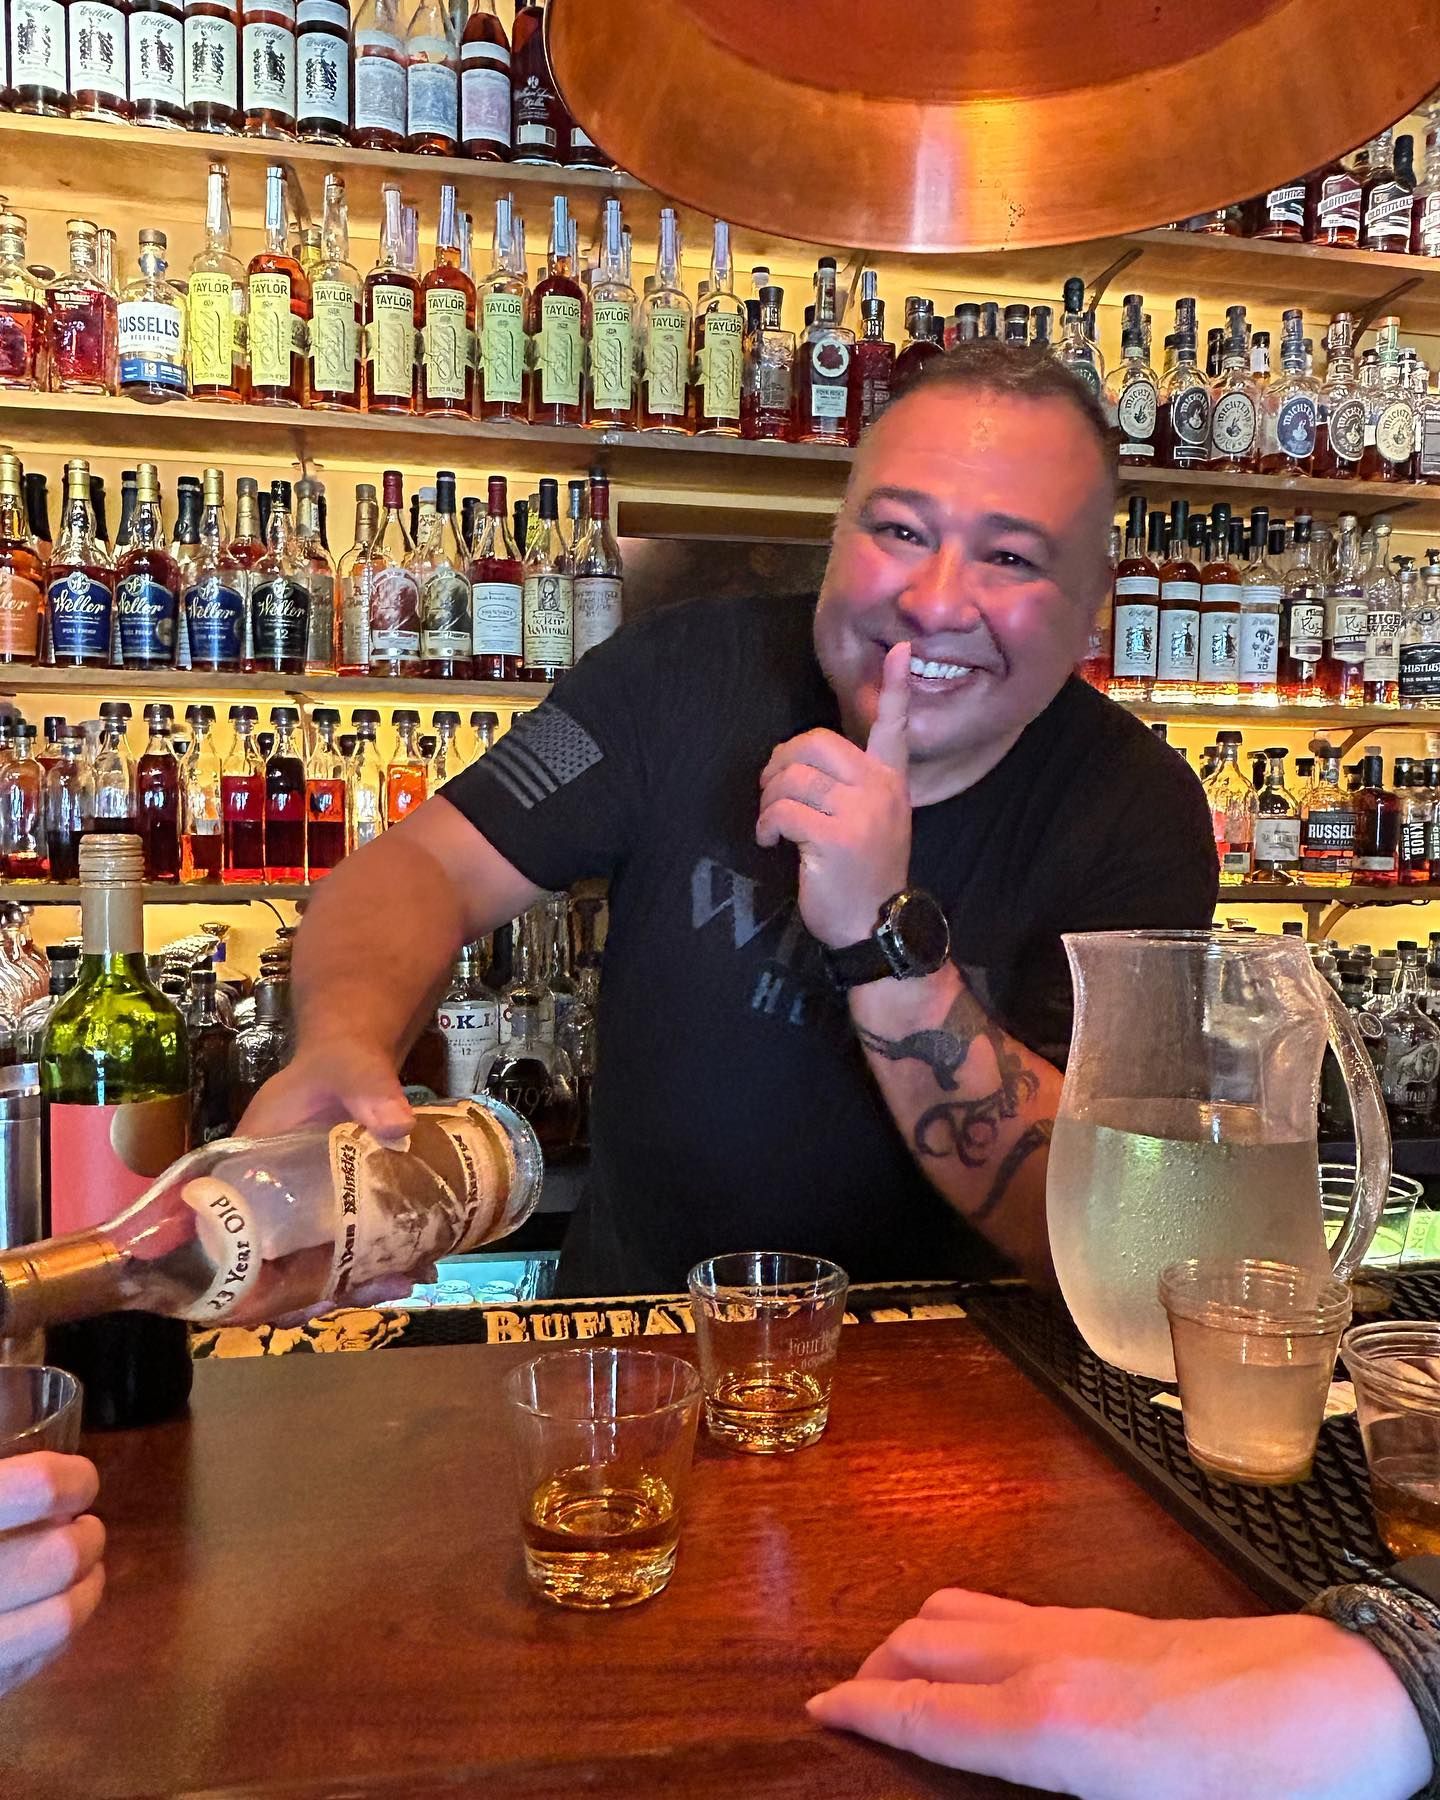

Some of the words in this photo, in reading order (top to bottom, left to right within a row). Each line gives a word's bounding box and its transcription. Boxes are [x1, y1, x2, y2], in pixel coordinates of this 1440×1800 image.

[193, 282, 229, 295] TAYLOR
[251, 283, 288, 295] TAYLOR
[315, 290, 353, 302] TAYLOR
[375, 295, 412, 310] TAYLOR
[428, 298, 464, 311] TAYLOR
[485, 302, 521, 314] TAYLOR
[594, 310, 630, 322] TAYLOR
[53, 588, 105, 614] Weller
[118, 592, 164, 615] Weller
[187, 596, 235, 619] Weller
[258, 593, 306, 618] Weller
[1403, 827, 1411, 861] CREEK
[1410, 822, 1424, 855] KNOB
[209, 1195, 245, 1234] Old
[224, 1240, 251, 1285] Year
